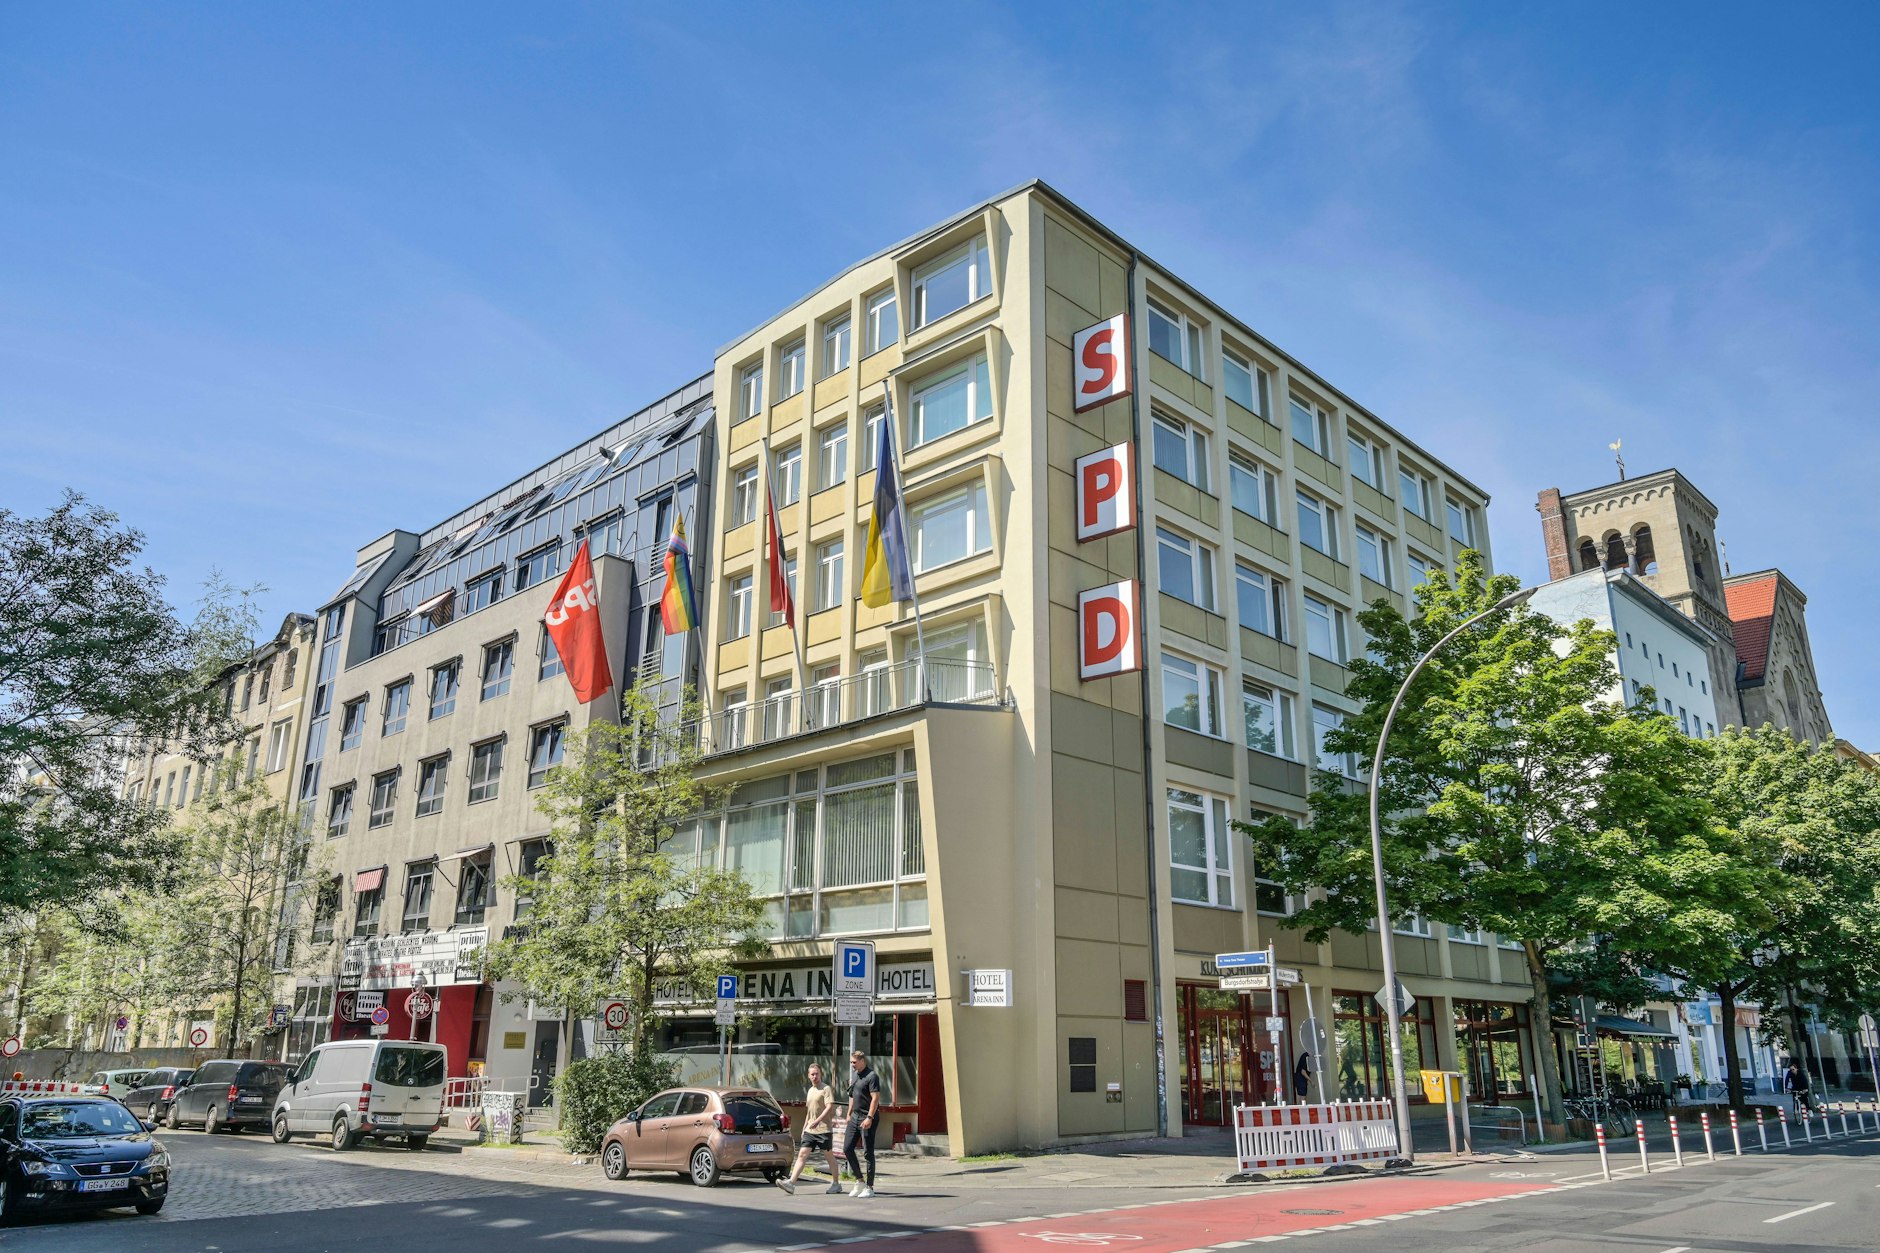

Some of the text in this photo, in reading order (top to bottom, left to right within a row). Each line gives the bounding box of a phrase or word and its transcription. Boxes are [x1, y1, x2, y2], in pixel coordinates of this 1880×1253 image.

[460, 933, 484, 946] prime
[849, 952, 861, 974] P
[721, 979, 733, 996] P
[807, 970, 833, 996] IN
[845, 981, 864, 989] ZONE
[881, 969, 931, 991] HOTEL
[972, 974, 1004, 986] HOTEL
[656, 981, 690, 998] HOTEL
[972, 995, 1004, 1003] ARENA INN
[610, 1011, 623, 1023] 30
[1260, 1051, 1274, 1070] SP
[88, 1181, 98, 1189] GG
